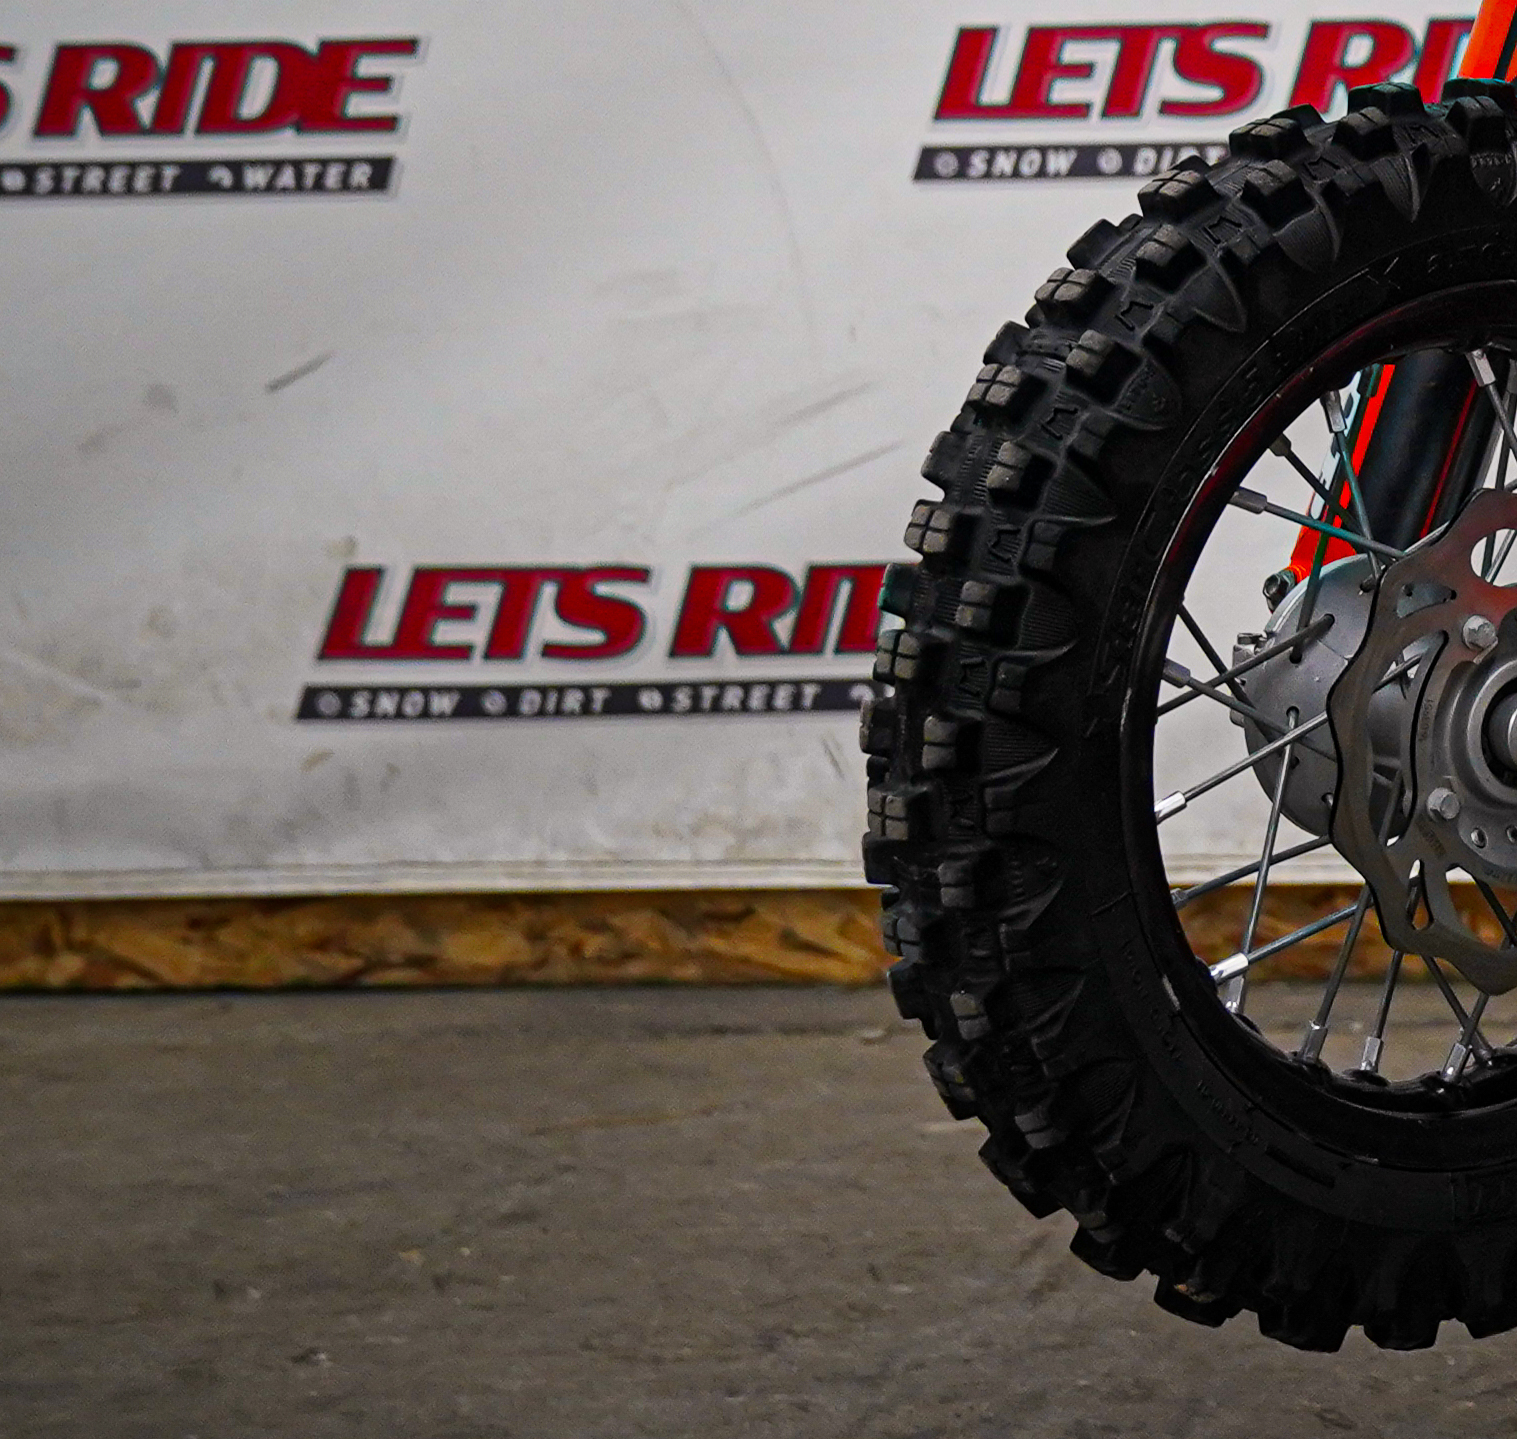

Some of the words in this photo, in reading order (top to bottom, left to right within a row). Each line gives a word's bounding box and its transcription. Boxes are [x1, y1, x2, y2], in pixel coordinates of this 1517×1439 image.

[33, 38, 420, 137] RIDE
[933, 23, 1271, 122] LETS
[33, 167, 181, 195] STREET
[242, 163, 374, 191] WATER
[968, 148, 1076, 179] SNOW
[317, 566, 651, 661] LETS
[349, 690, 459, 718] SNOW
[519, 687, 611, 715] DIRT
[671, 682, 821, 712] STREET
